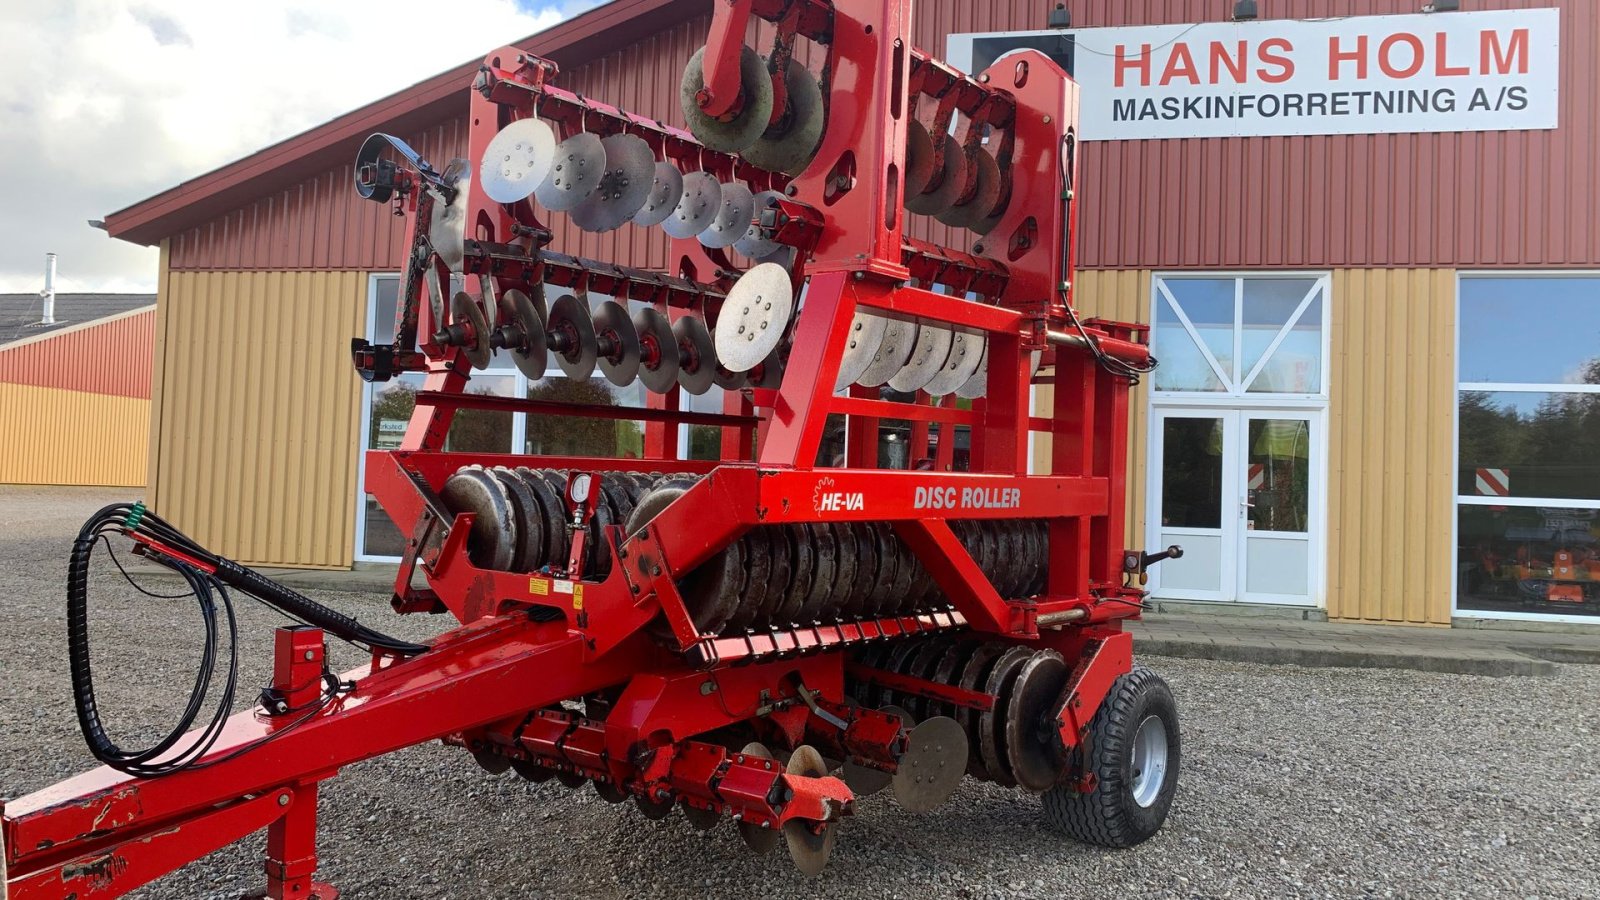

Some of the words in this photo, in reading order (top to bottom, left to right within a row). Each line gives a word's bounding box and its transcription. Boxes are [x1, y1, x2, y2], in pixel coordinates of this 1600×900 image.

[1114, 38, 1295, 87] HANS
[1328, 28, 1529, 80] HOLM
[1112, 89, 1455, 121] MASKINFORRETNING
[1468, 86, 1528, 111] A/S
[821, 492, 865, 511] HE-VA
[914, 486, 957, 509] DISC
[961, 487, 1021, 509] ROLLER
